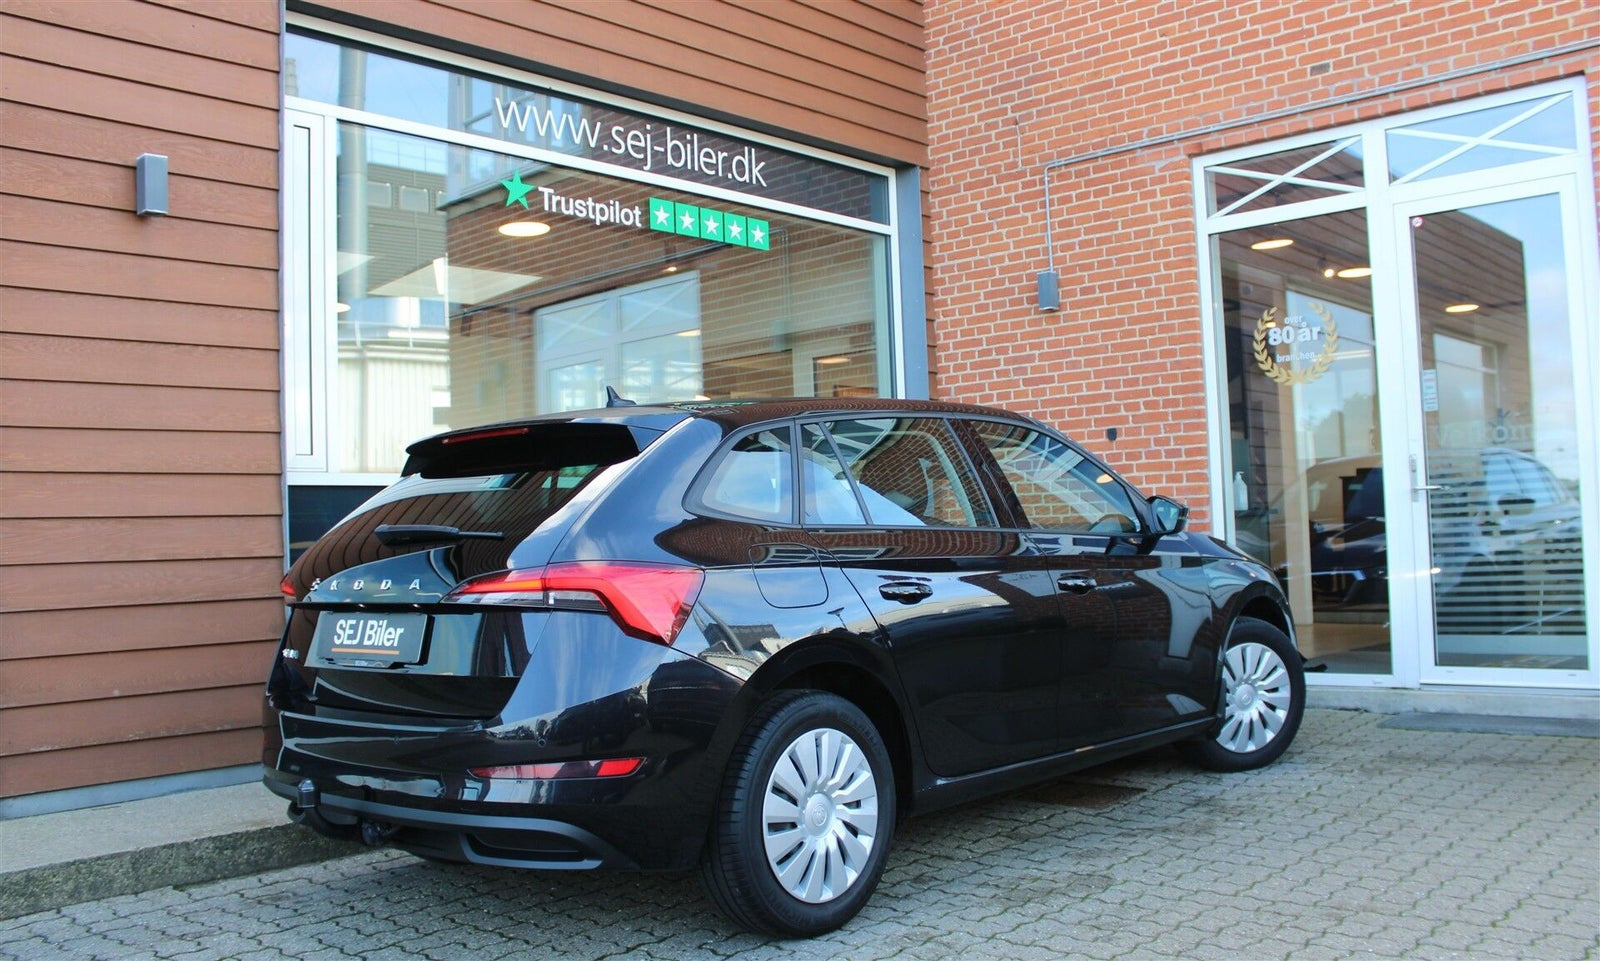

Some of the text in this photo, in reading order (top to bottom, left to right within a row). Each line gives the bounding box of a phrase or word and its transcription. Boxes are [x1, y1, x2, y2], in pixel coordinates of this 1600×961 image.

[495, 97, 768, 187] www.sej-biler.dk
[538, 186, 643, 228] Trustpilot
[1268, 321, 1321, 346] 80 år
[1284, 315, 1303, 325] over
[333, 619, 405, 647] SEJ Biler
